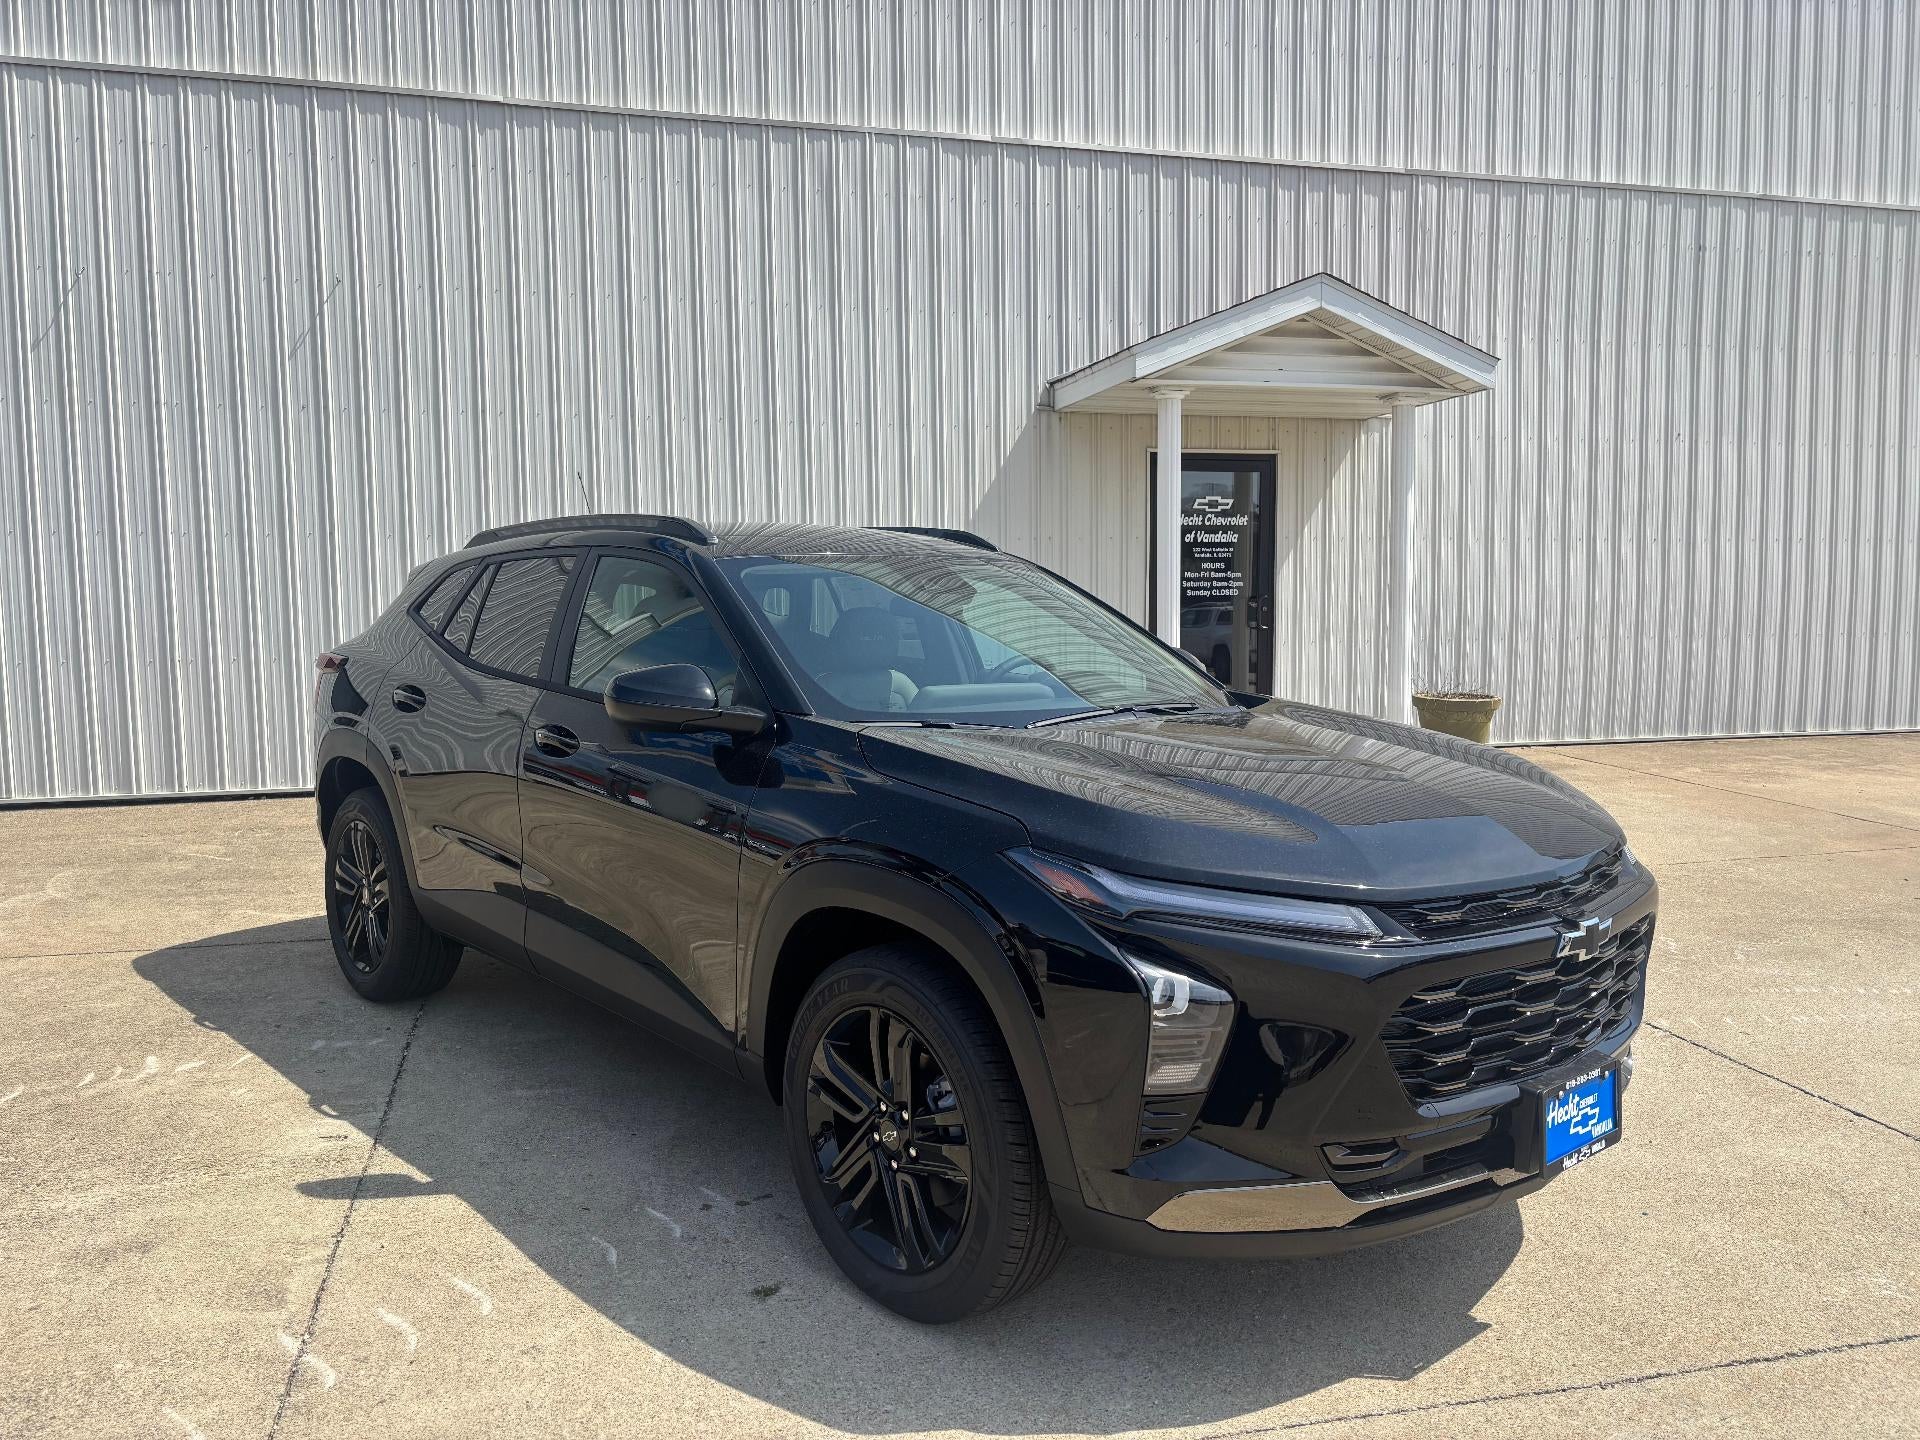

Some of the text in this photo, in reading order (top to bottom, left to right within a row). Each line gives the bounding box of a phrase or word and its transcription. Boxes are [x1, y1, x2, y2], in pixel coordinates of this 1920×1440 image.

[1205, 514, 1249, 525] Chevrolet
[1184, 530, 1239, 542] of Vandalia
[1547, 1093, 1580, 1129] Hecht
